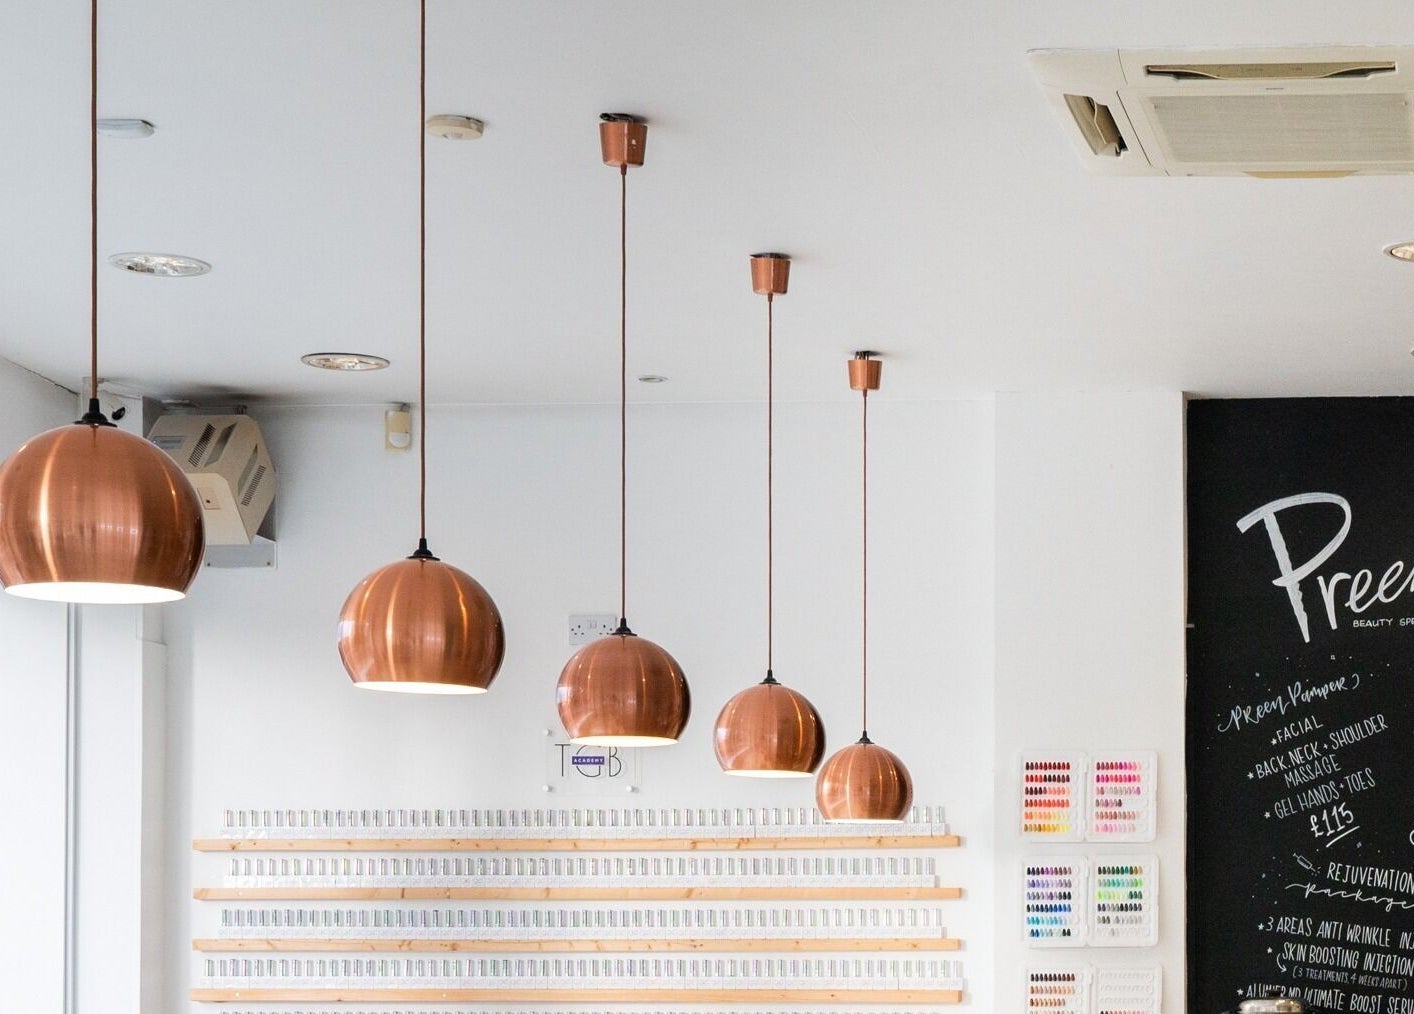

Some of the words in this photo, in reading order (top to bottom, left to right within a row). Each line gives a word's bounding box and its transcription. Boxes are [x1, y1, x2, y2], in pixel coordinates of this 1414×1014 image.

[1352, 618, 1394, 628] BEAUTY
[1275, 715, 1324, 743] FACIAL
[1329, 713, 1389, 751] SHOULDER
[1284, 753, 1342, 789] MASSAGE
[1274, 797, 1298, 819] GEL
[1299, 781, 1341, 812] HANDS
[1344, 767, 1376, 795] TOES
[1309, 802, 1354, 838] £115
[1265, 916, 1275, 932] 3
[1276, 916, 1313, 937] AREAS
[1316, 920, 1344, 941] ANTI
[1346, 923, 1392, 948] WRINKLE
[1282, 941, 1307, 963] SKIN
[1308, 944, 1360, 970] BOOSTING
[1358, 975, 1380, 987] WEEKS
[1349, 993, 1382, 1014] BOOST
